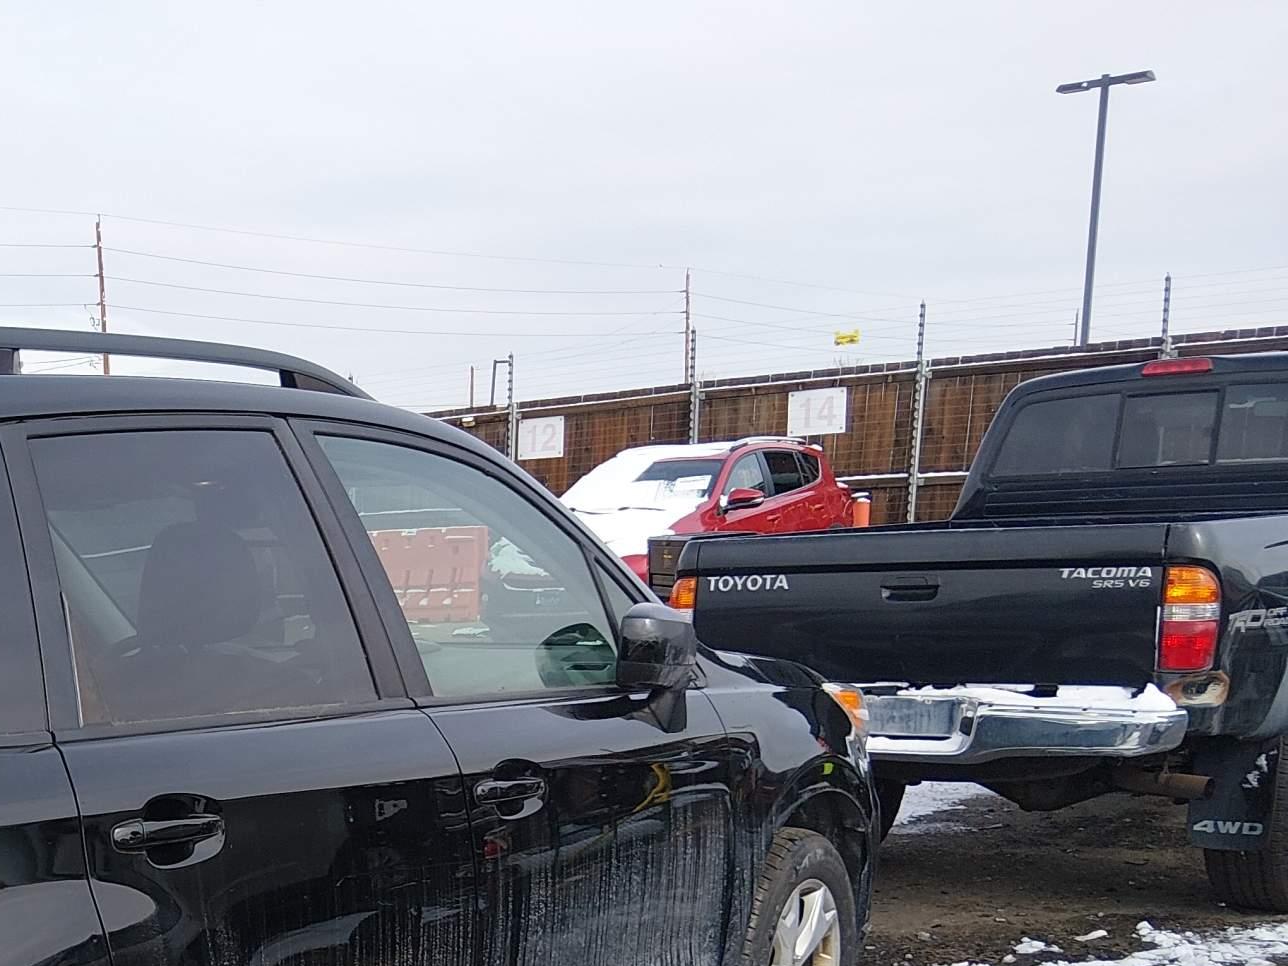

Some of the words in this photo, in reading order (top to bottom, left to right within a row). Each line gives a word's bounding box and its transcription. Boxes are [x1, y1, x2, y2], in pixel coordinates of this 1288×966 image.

[799, 395, 837, 428] 14
[1059, 566, 1153, 579] TACOMA
[707, 574, 789, 592] TOYOTA
[1091, 579, 1125, 589] SR5
[1128, 578, 1152, 588] V6
[1193, 820, 1264, 835] 4WD
